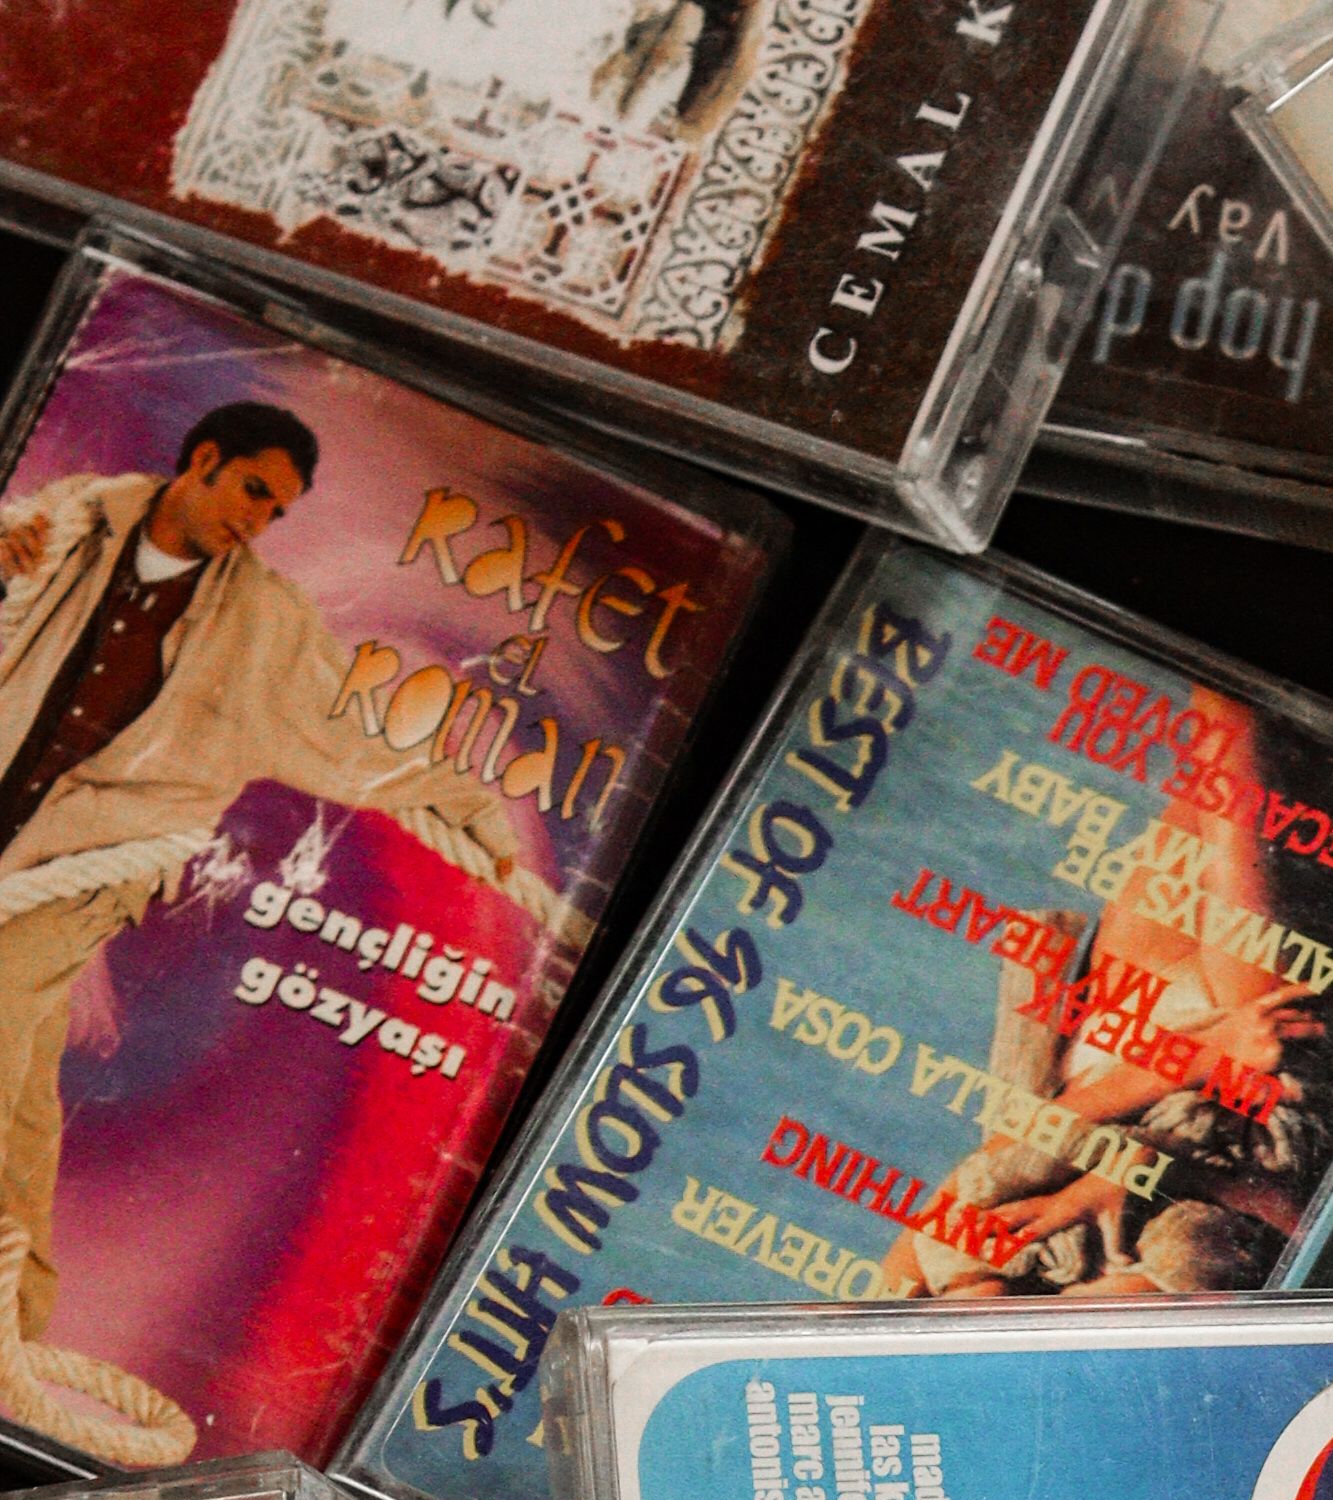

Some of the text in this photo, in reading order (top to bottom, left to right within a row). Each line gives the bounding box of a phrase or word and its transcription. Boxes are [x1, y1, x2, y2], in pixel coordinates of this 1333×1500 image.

[808, 87, 972, 376] CEMAL
[1047, 695, 1162, 785] YOU
[1063, 654, 1239, 771] LOVED
[968, 739, 1123, 848] BABY
[243, 879, 518, 1022] gençliğin
[538, 609, 952, 1253] BEST OF 96 SLOW
[888, 857, 1078, 984] HEART
[235, 953, 466, 1080] gözyaşı
[760, 976, 906, 1079] COSA
[1013, 964, 1287, 1125] UN BREAK
[899, 1039, 1077, 1159] BELLA
[759, 1112, 1032, 1276] ANYTHING
